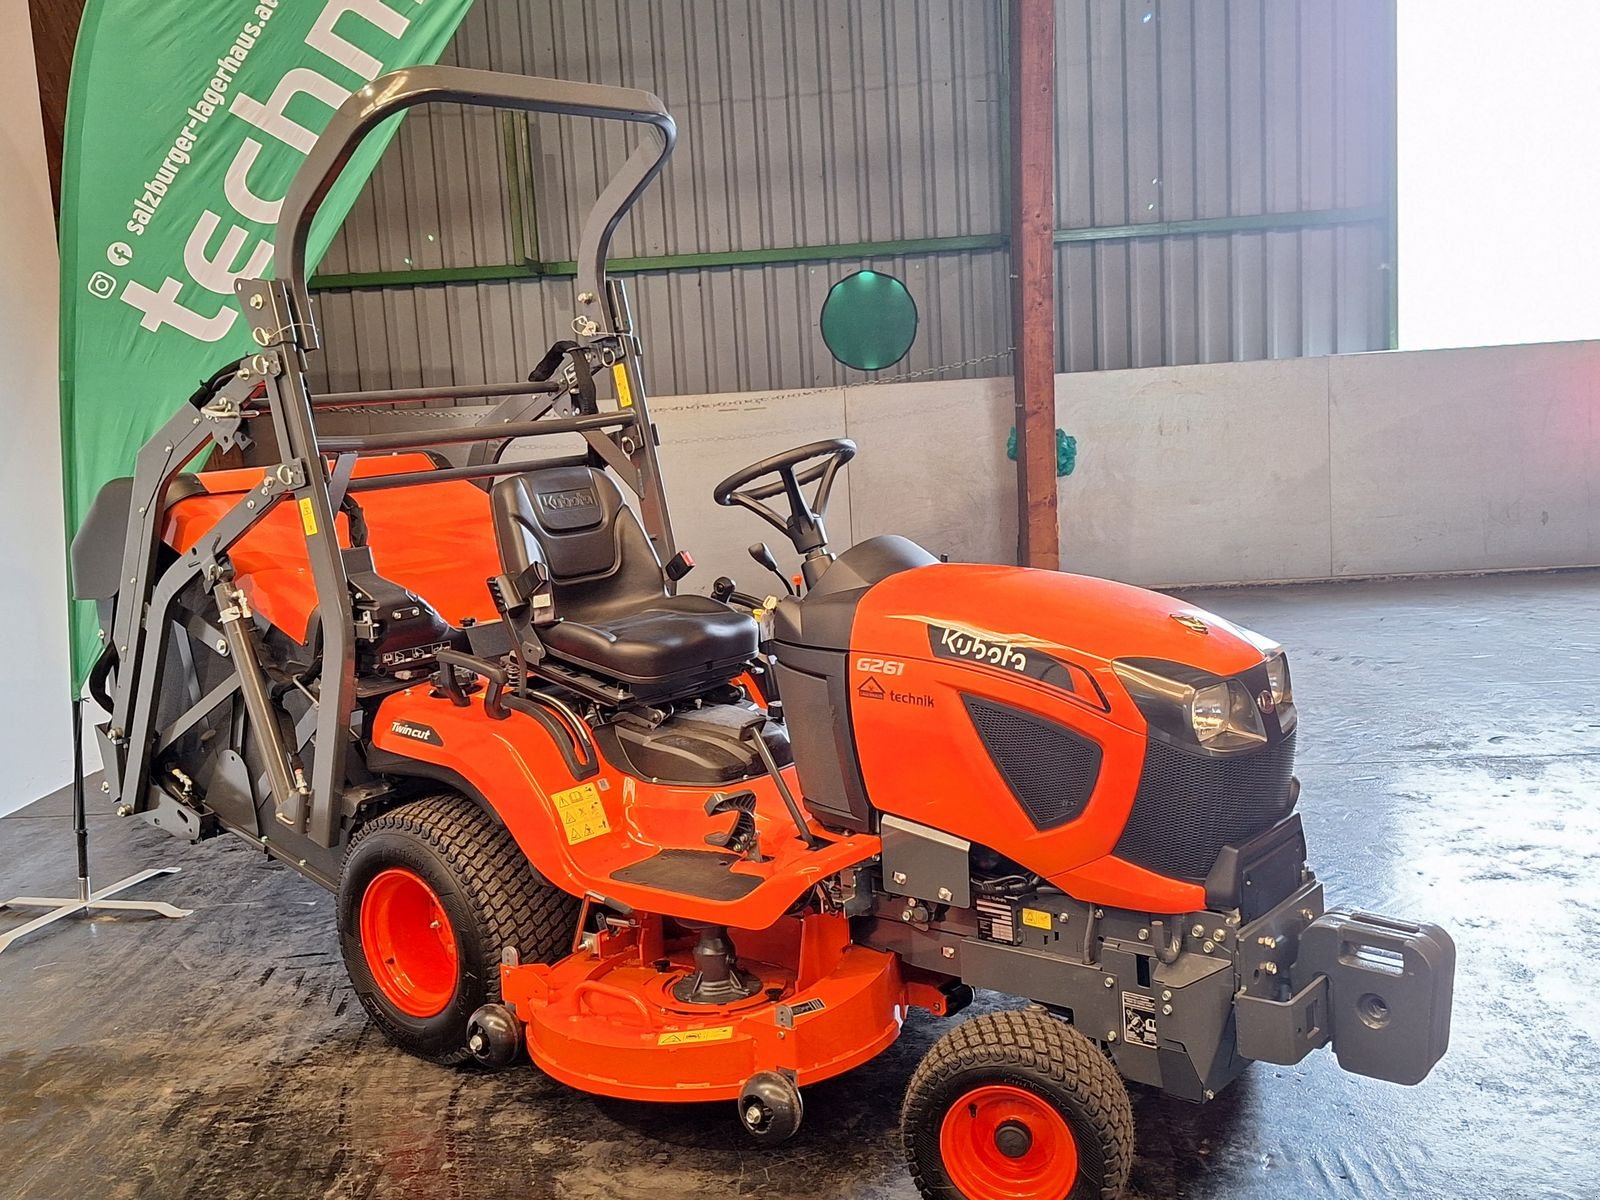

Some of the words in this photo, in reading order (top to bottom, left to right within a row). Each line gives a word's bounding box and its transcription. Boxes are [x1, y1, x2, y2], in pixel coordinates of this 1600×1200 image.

[120, 0, 425, 342] techn
[542, 494, 594, 510] Kubota
[941, 627, 1027, 672] Kubota
[857, 657, 905, 676] G261
[889, 690, 935, 708] technik
